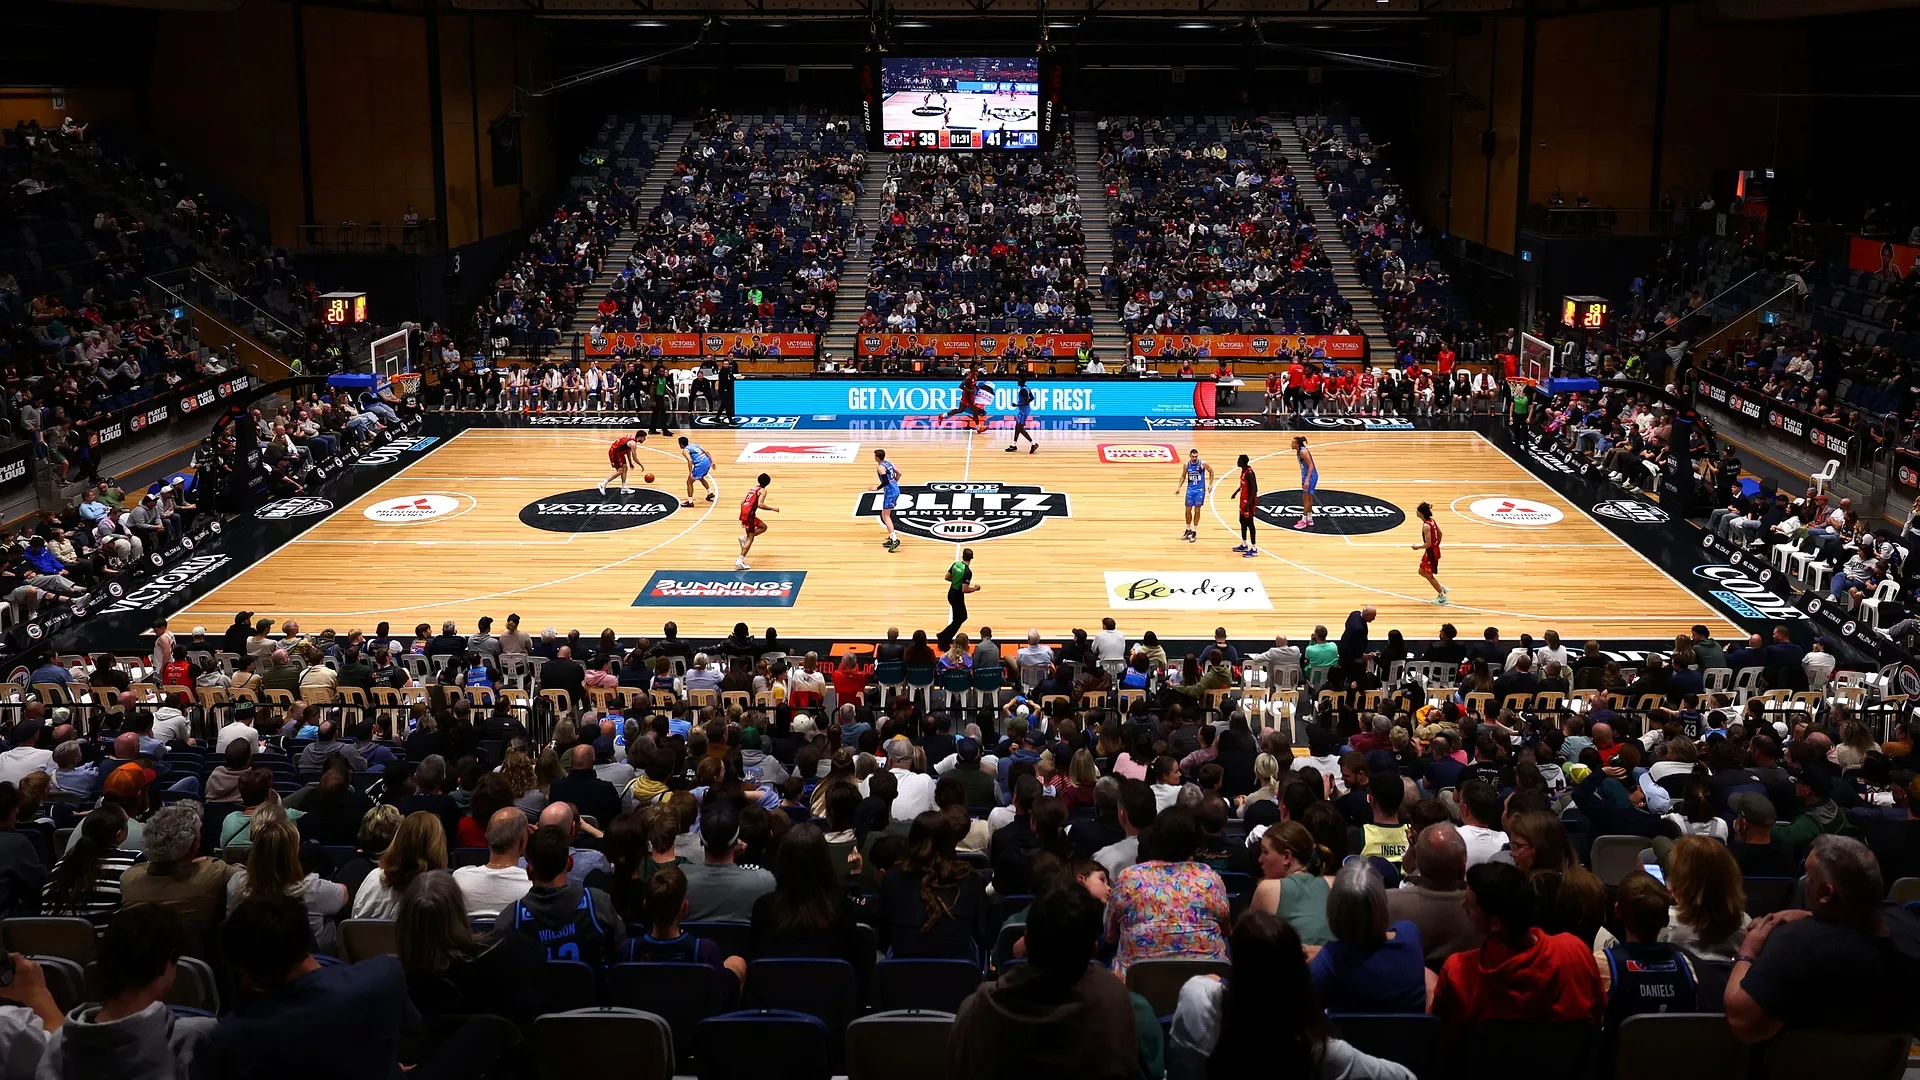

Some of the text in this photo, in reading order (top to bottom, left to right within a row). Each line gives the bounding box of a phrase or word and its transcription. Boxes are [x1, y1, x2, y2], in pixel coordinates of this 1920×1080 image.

[863, 101, 871, 131] arena
[1045, 101, 1053, 131] arena
[919, 132, 937, 146] 39
[951, 133, 971, 145] 01:31
[986, 132, 1001, 146] 41
[454, 254, 460, 273] 3
[327, 309, 345, 322] 20
[1584, 313, 1601, 326] 20
[232, 381, 248, 393] LOUD
[199, 394, 215, 406] LOUD
[848, 387, 877, 410] GET
[1710, 391, 1726, 403] LOUD
[1743, 400, 1755, 410] PLAY
[147, 408, 161, 417] PLAY
[148, 411, 168, 425] LOUD
[1742, 405, 1760, 419] LOUD
[1310, 417, 1413, 426] CODE
[1784, 416, 1796, 427] PLAY
[99, 426, 114, 436] PLAY
[100, 429, 122, 444] LOUD
[1784, 423, 1802, 437] LOUD
[1827, 434, 1841, 445] PLAY
[1827, 441, 1847, 456] LOUD
[930, 483, 1000, 492] CODE
[536, 503, 668, 512] VICTORIA
[871, 493, 1052, 511] BLITZ
[1255, 505, 1396, 514] VICTORIA
[944, 525, 975, 533] NBL
[98, 552, 227, 615] VICTORIA
[655, 579, 793, 590] BUNNINGS
[1125, 578, 1255, 602] Bendigo
[661, 588, 783, 597] warehouse
[1703, 565, 1811, 620] CODE
[1715, 590, 1761, 618] SPORTS
[44, 612, 68, 628] NBL.COM.AU
[1822, 609, 1842, 624] NBL.COM.AU
[1684, 724, 1697, 737] 43
[1381, 844, 1407, 856] INGLES
[538, 922, 577, 943] WILSON
[1640, 984, 1675, 998] DANIELS
